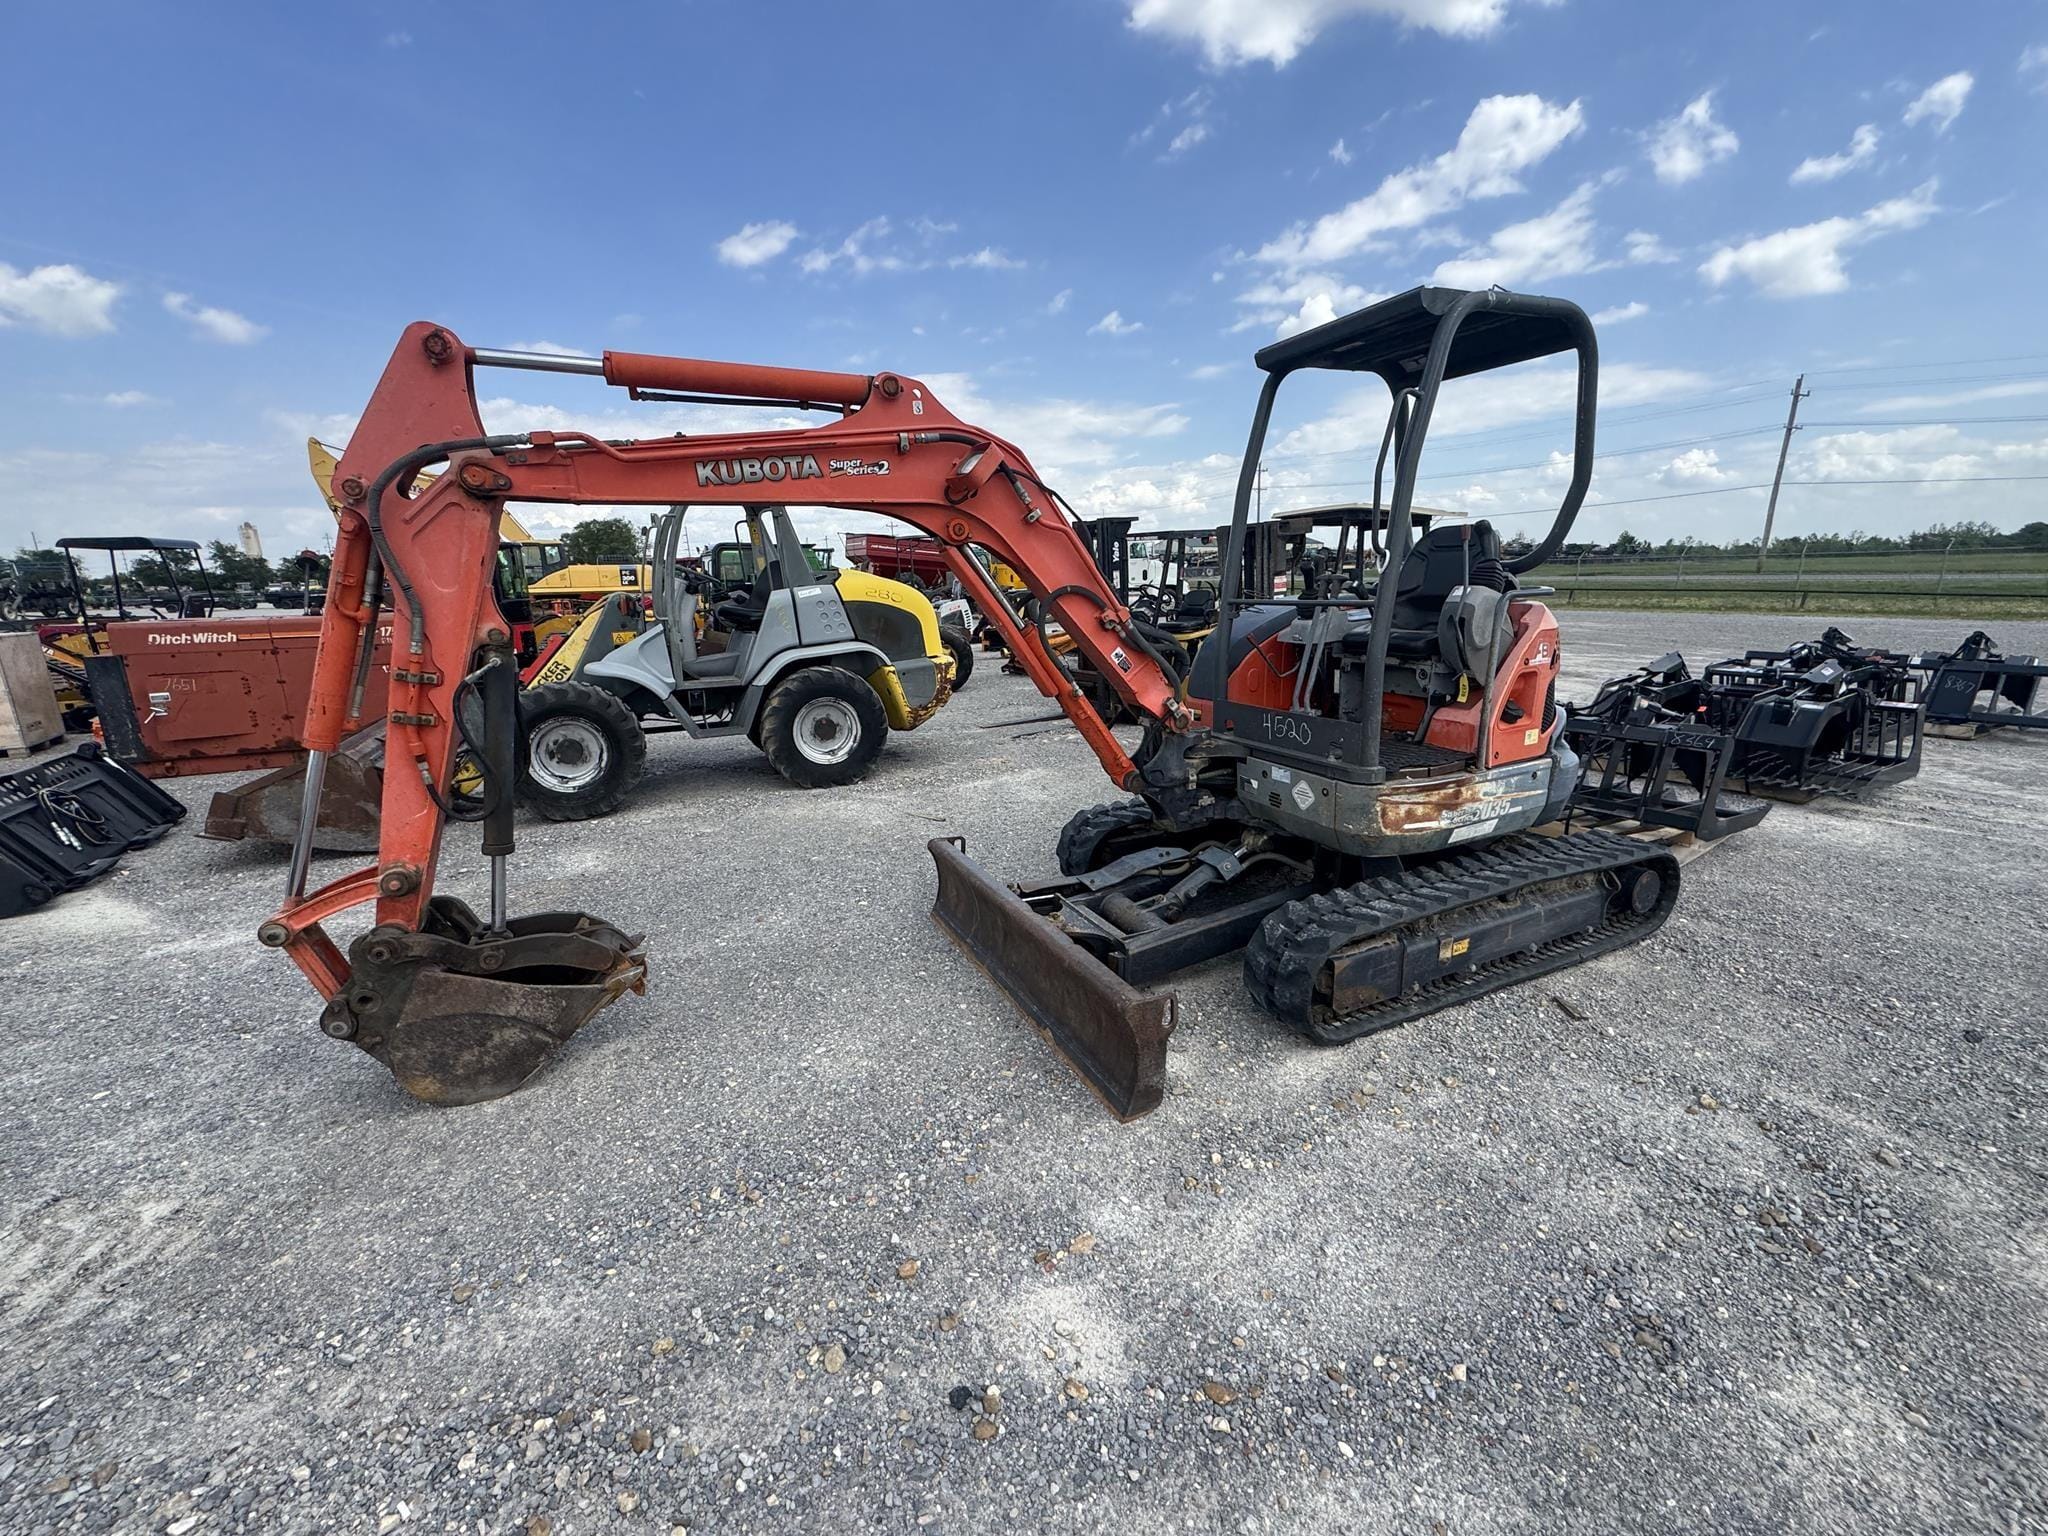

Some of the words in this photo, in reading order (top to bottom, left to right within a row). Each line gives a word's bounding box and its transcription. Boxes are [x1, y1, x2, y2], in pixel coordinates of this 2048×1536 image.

[695, 455, 823, 487] KUBOTA
[829, 459, 862, 470] Super
[846, 464, 879, 476] Series
[878, 460, 890, 475] 2
[148, 633, 191, 645] Ditch
[192, 632, 237, 644] Witch
[379, 626, 394, 637] 17
[164, 678, 197, 692] 7651
[1263, 712, 1311, 745] 4520
